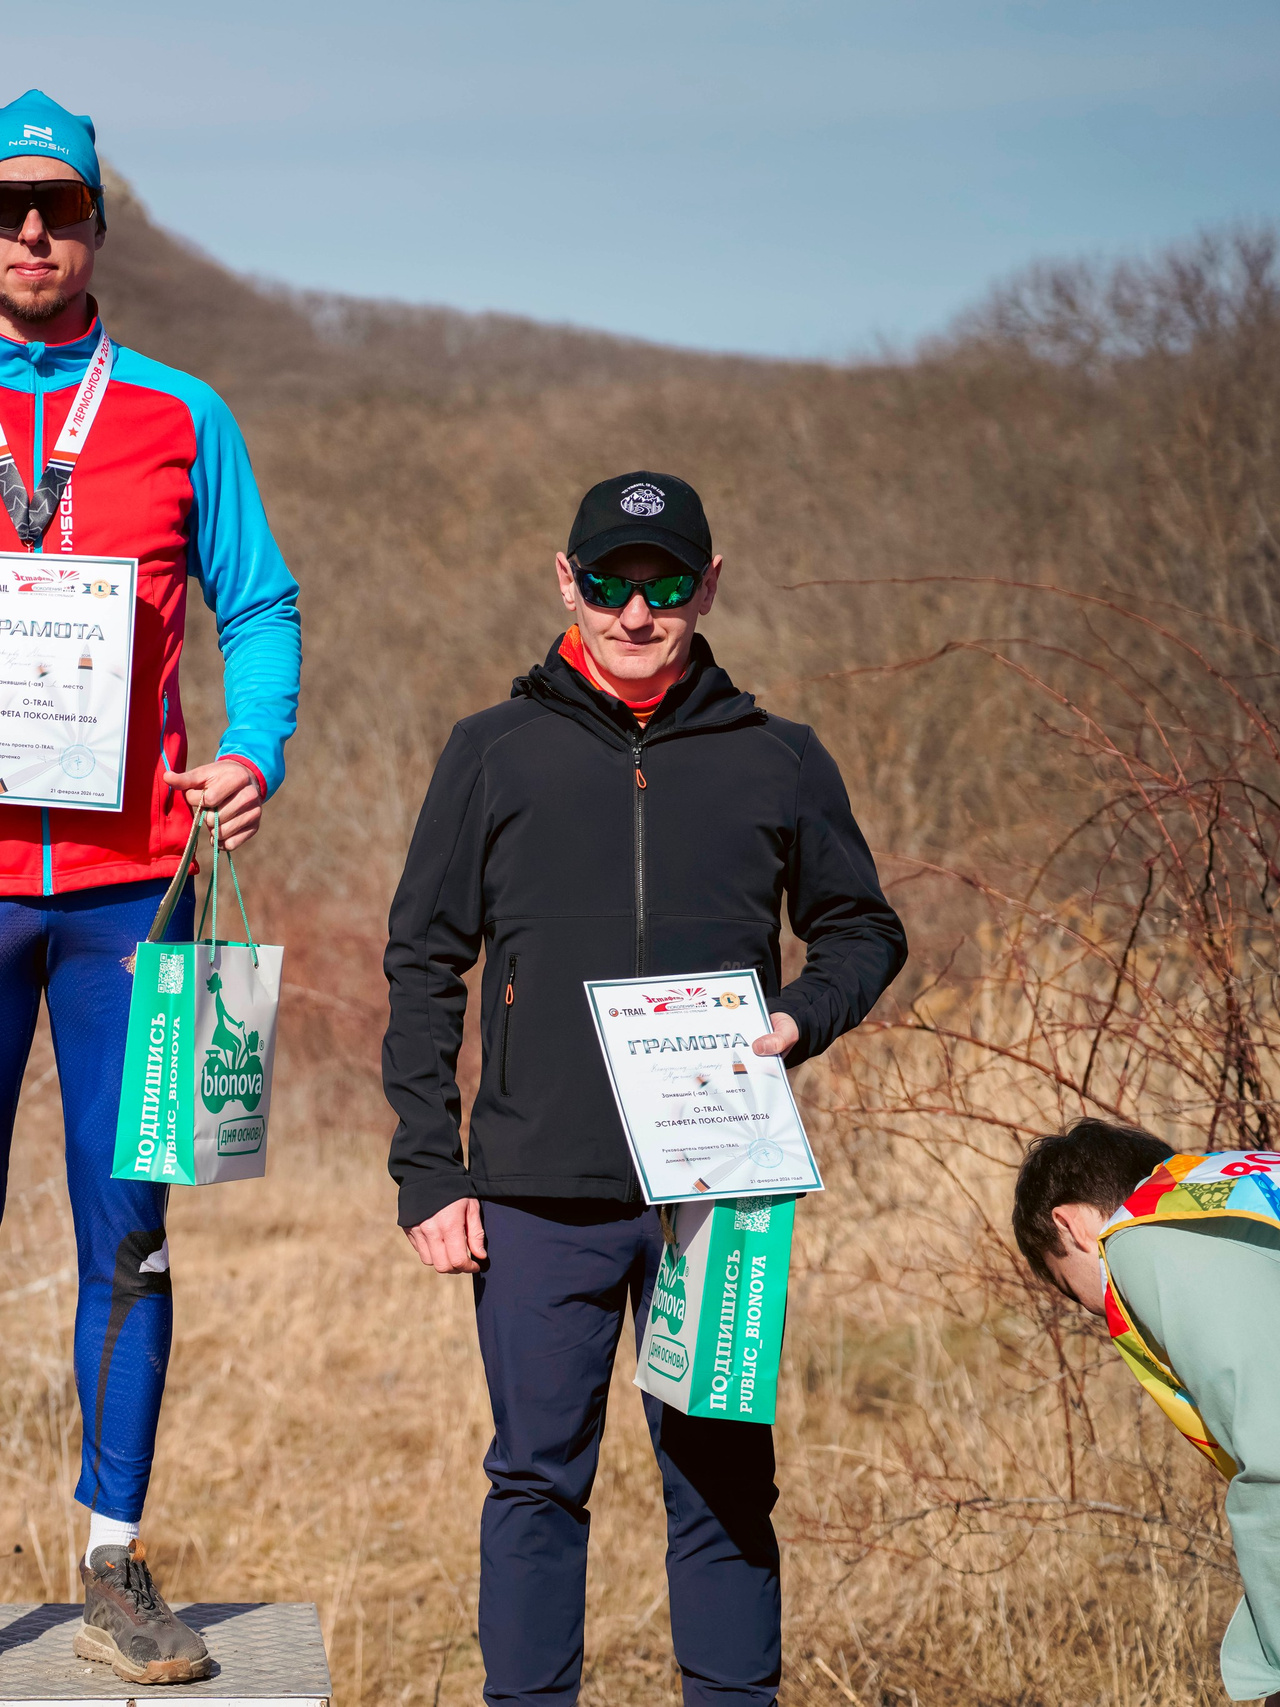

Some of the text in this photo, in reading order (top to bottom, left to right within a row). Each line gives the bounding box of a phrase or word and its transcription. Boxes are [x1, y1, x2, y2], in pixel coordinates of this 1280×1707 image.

[8, 139, 70, 156] NORDSKI
[73, 366, 102, 427] ЛЕРМОНТОВ
[60, 475, 73, 552] RDSKI
[22, 698, 54, 708] O-TRAIL
[24, 711, 76, 722] ПОКОЛЕНИЙ
[78, 716, 98, 724] 2026
[628, 1033, 750, 1055] ГРАМОТА
[203, 1064, 262, 1097] bionova
[134, 1012, 166, 1173] ПОДПИШИСЬ
[163, 1016, 180, 1176] PUBLIC_BIONOVA
[655, 1118, 698, 1128] ЭСТАФЕТА
[699, 1113, 750, 1124] ПОКОЛЕНИЙ
[693, 1105, 724, 1114] O-TRAIL
[221, 1127, 262, 1146] ДНЯ ОСНОВА
[710, 1250, 741, 1410] ПОДПИШИСЬ
[740, 1255, 766, 1414] PUBLIC_BIONOVA
[661, 1348, 684, 1370] ОСНОВА
